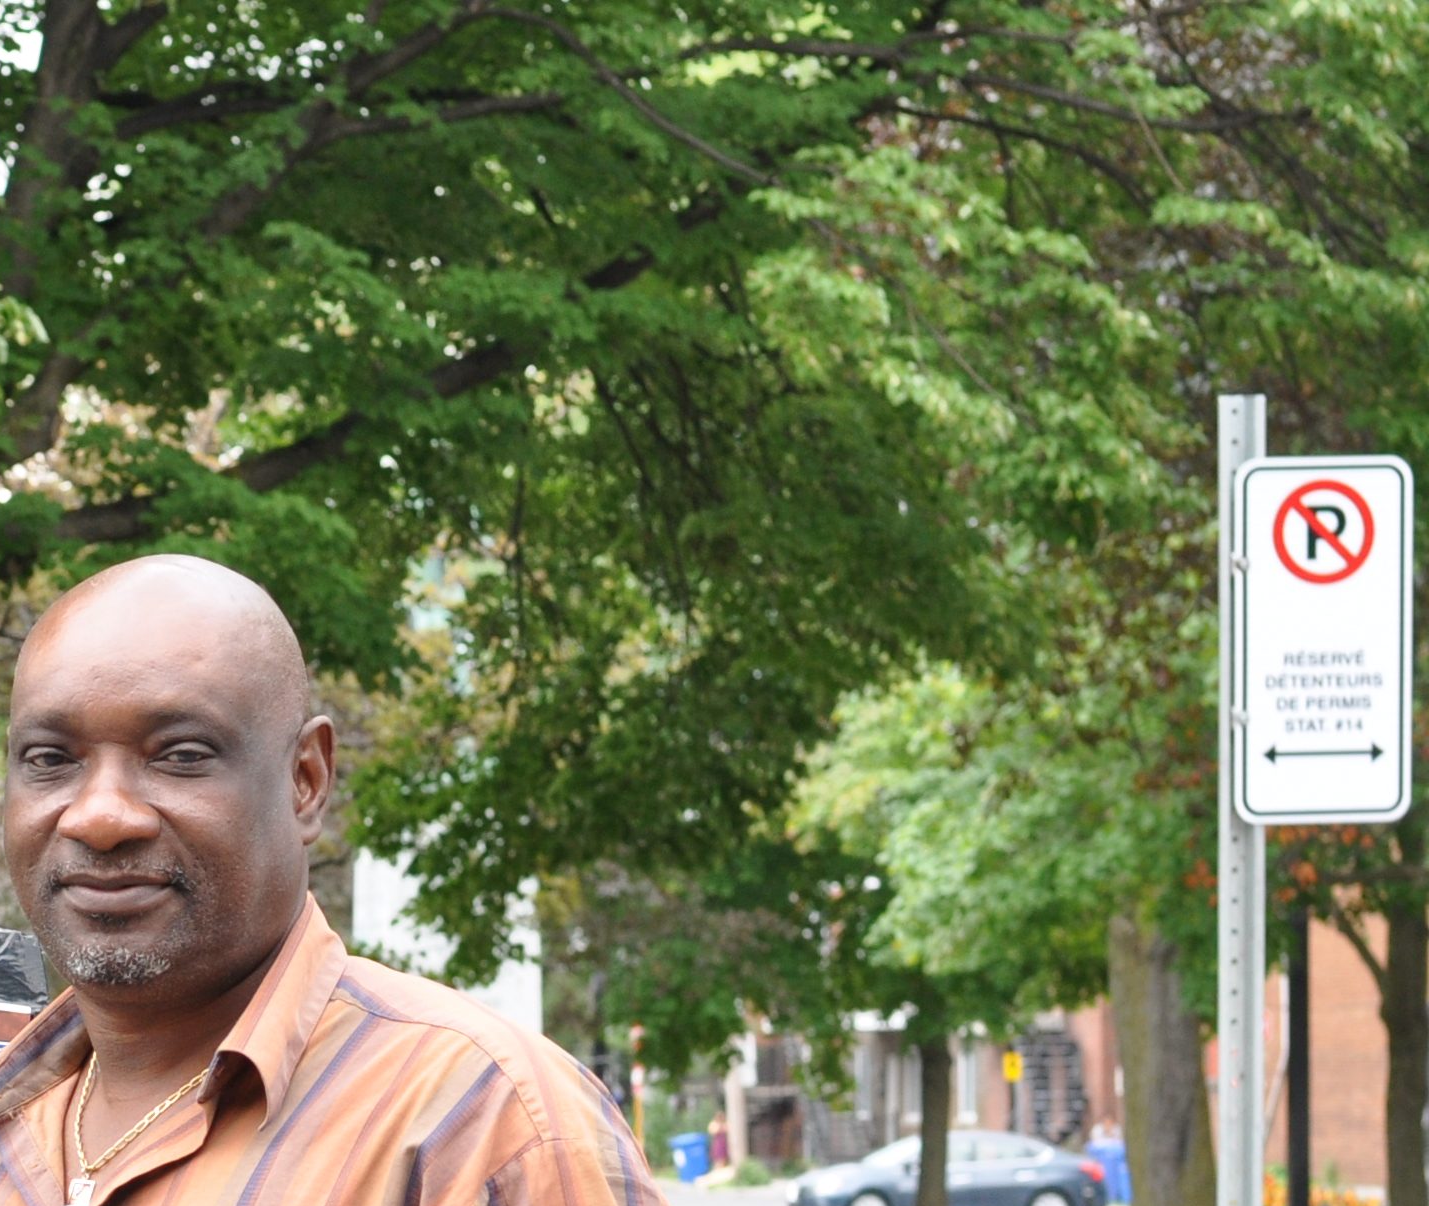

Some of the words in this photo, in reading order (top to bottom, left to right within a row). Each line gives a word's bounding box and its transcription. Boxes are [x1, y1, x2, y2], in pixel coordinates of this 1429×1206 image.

[1283, 649, 1365, 667] RÉSERVÉ
[1264, 672, 1383, 690] DÉTENTEURS
[1275, 696, 1298, 711] DE
[1305, 695, 1372, 710] PERMIS
